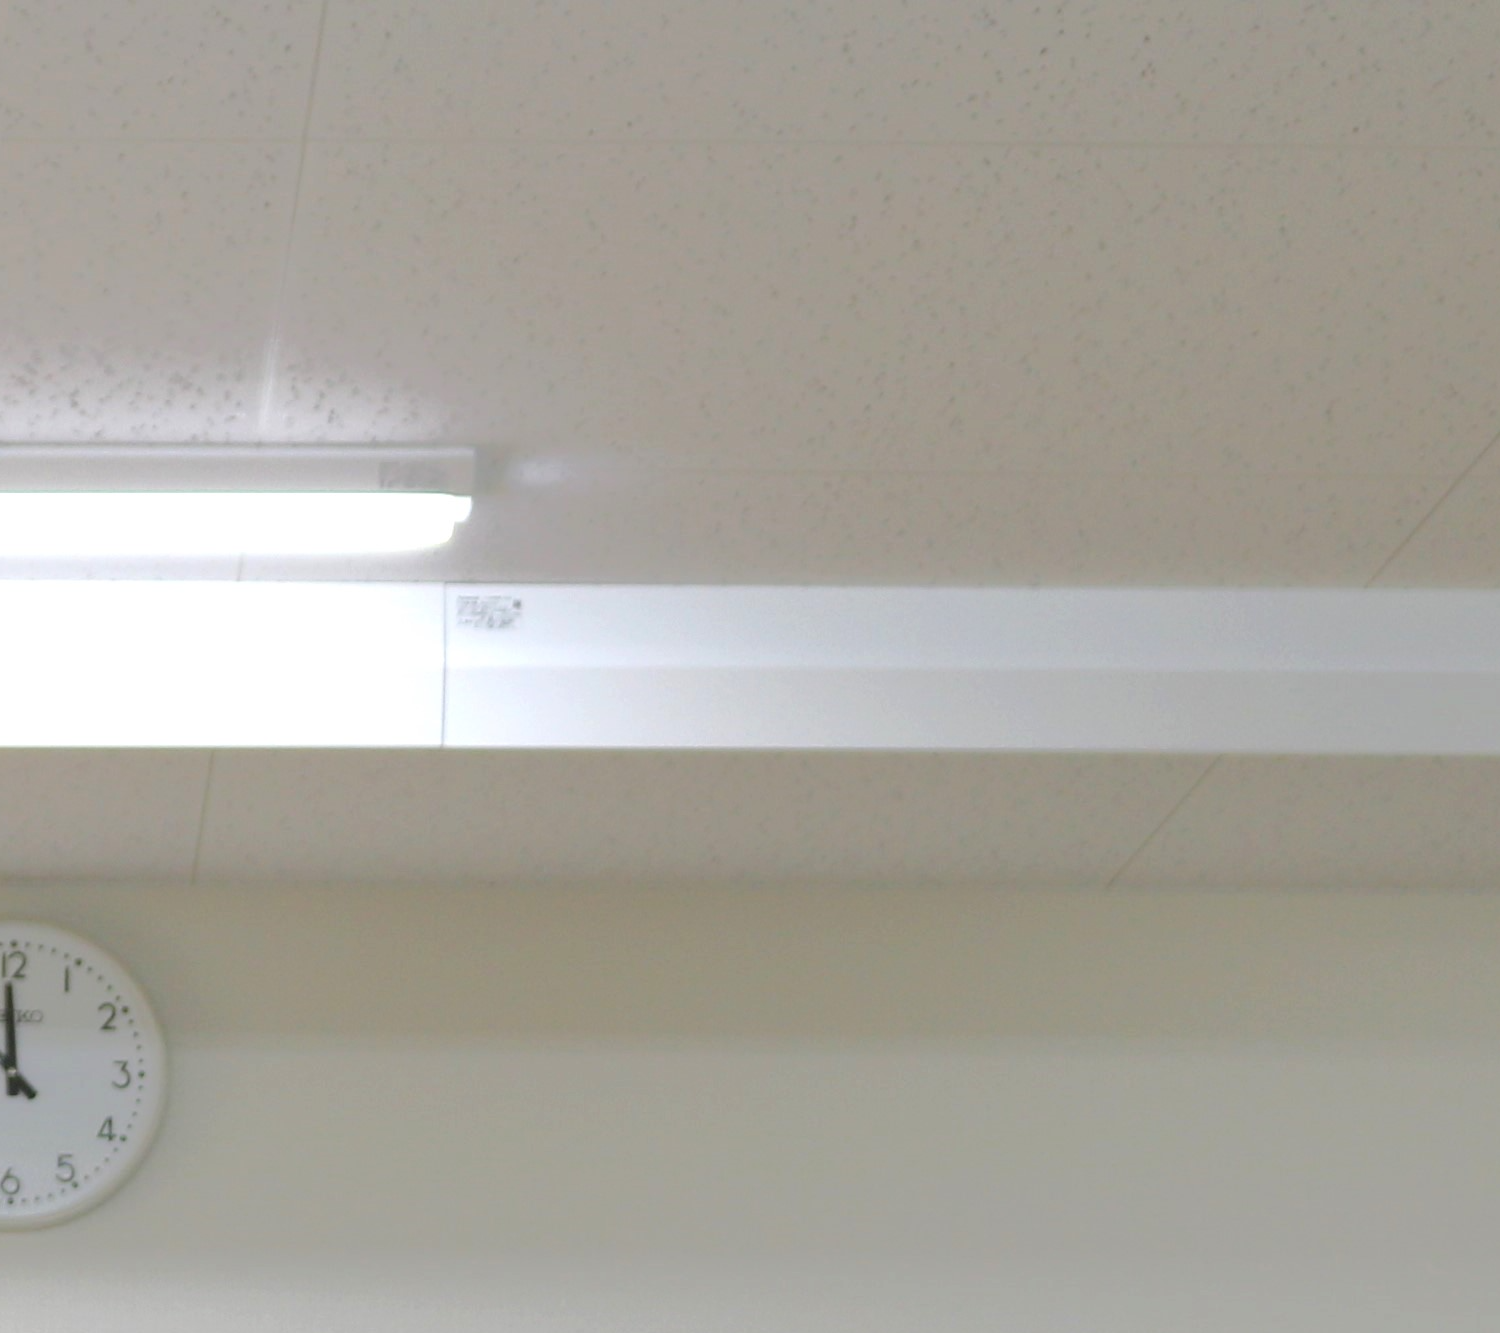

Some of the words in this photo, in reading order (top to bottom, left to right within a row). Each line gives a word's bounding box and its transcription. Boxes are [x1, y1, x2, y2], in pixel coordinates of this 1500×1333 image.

[1, 951, 27, 978] 12
[63, 966, 71, 992] 1
[98, 1003, 117, 1030] 2
[111, 1061, 131, 1088] 3
[97, 1116, 117, 1141] 4
[1, 1167, 20, 1195] 6
[56, 1154, 75, 1182] 5
